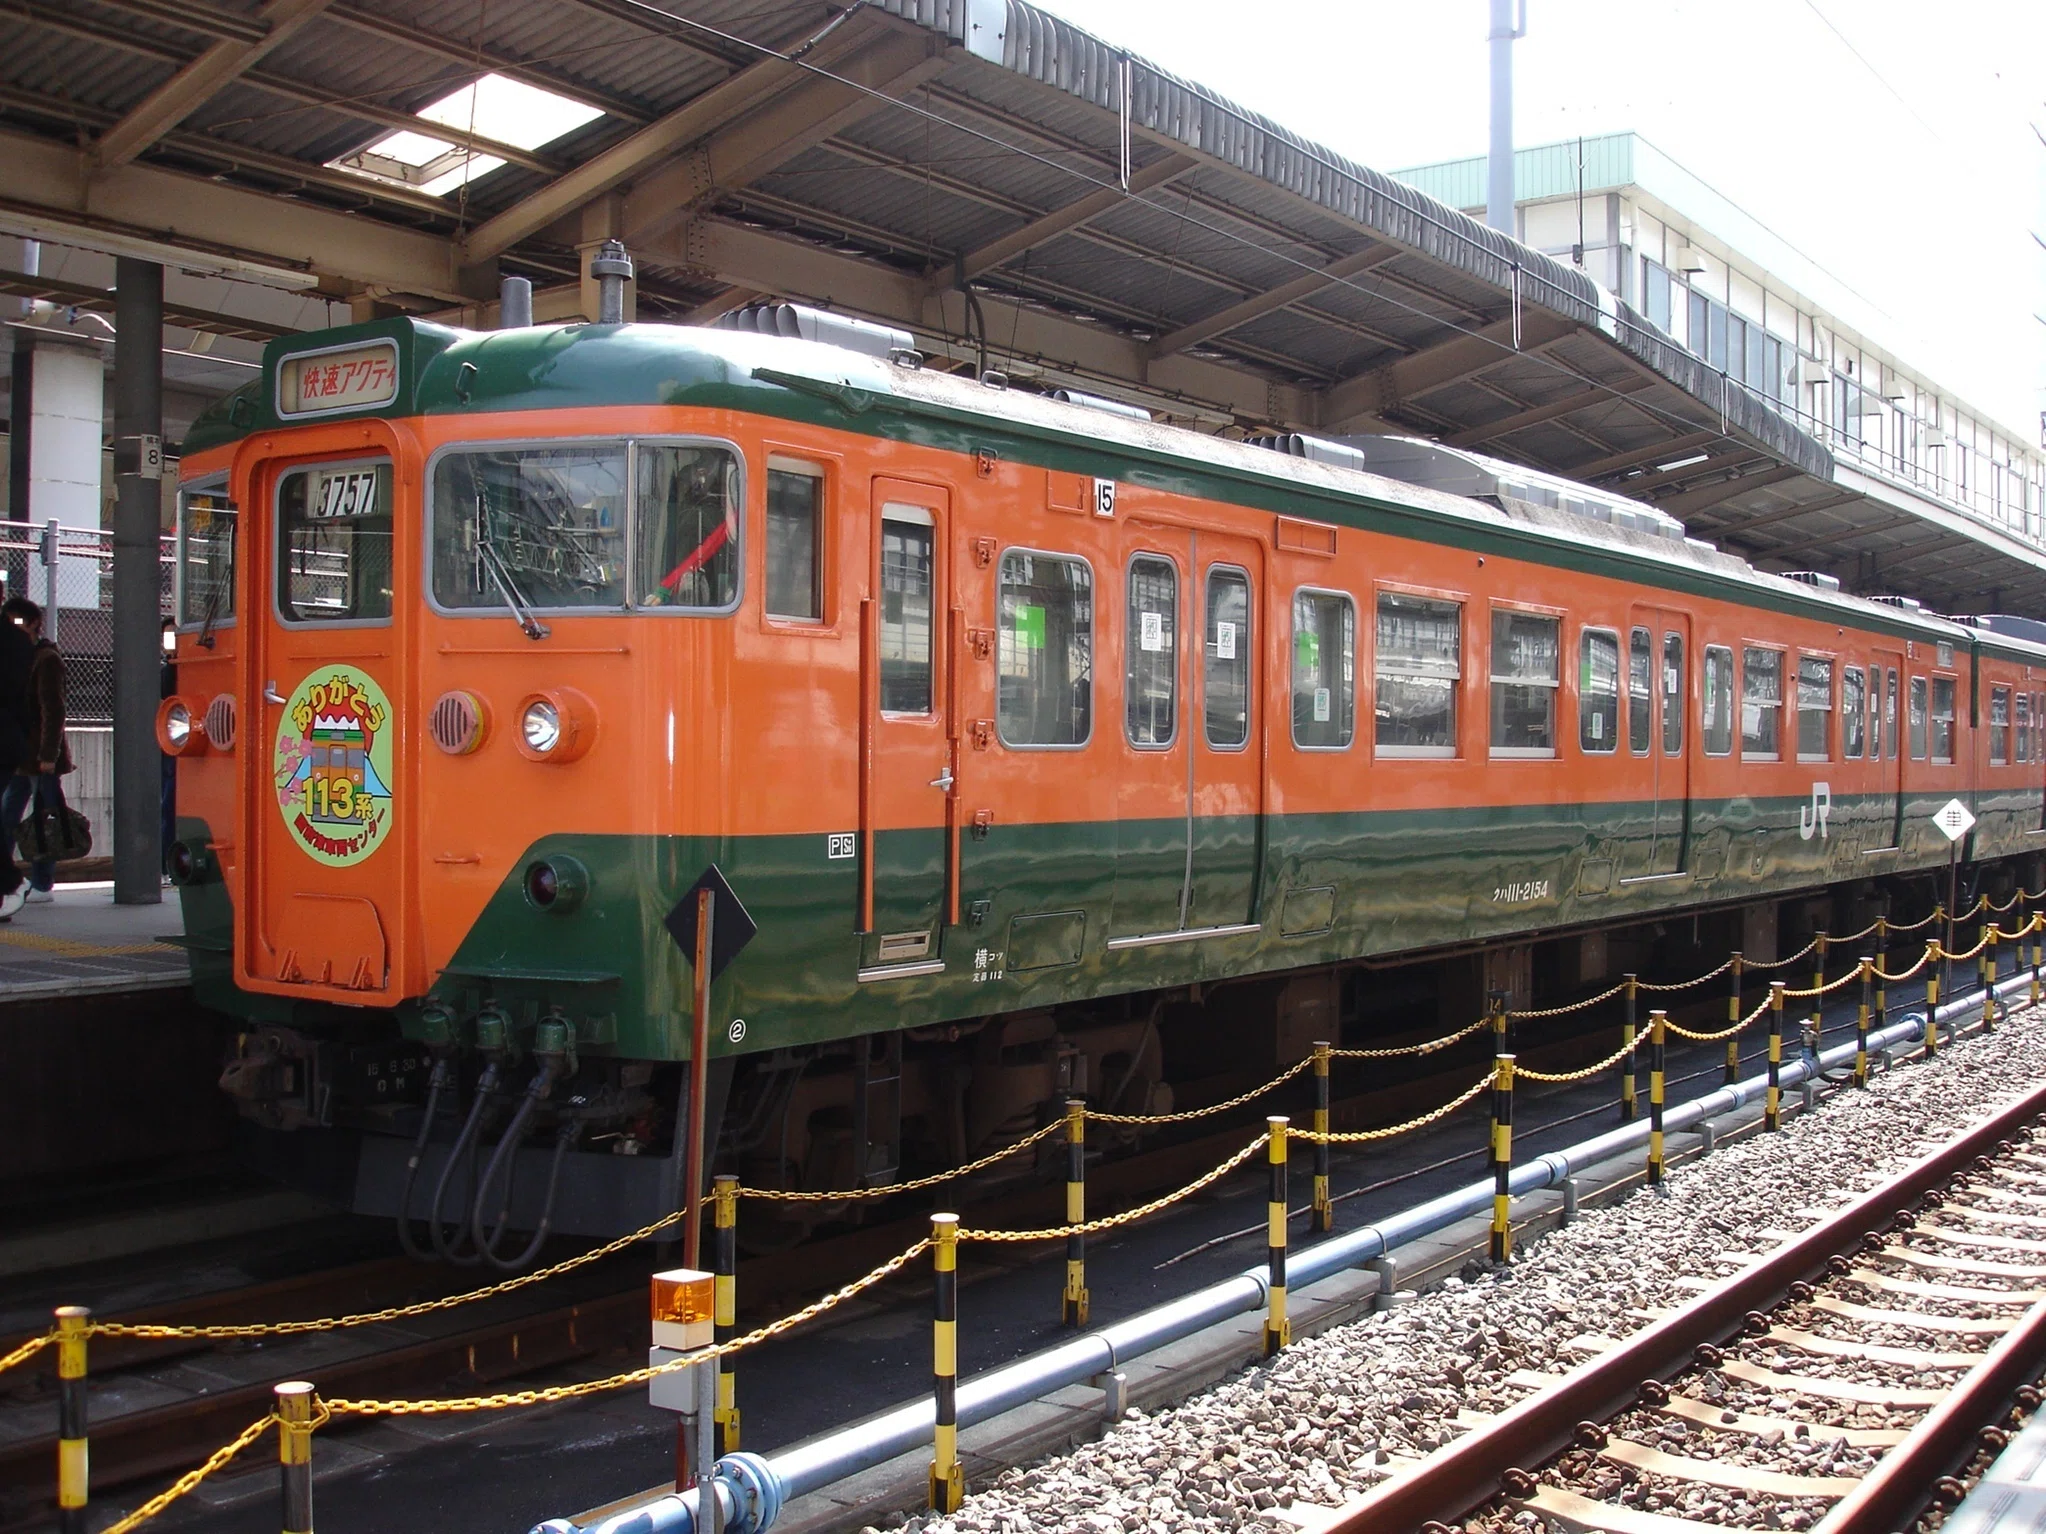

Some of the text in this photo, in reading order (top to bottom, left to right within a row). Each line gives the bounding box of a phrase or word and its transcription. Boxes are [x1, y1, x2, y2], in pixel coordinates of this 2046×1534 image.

[149, 450, 158, 465] 8
[317, 473, 374, 516] 3757
[1098, 483, 1112, 512] 15
[292, 675, 386, 733] ありがとう
[1800, 782, 1830, 840] JR
